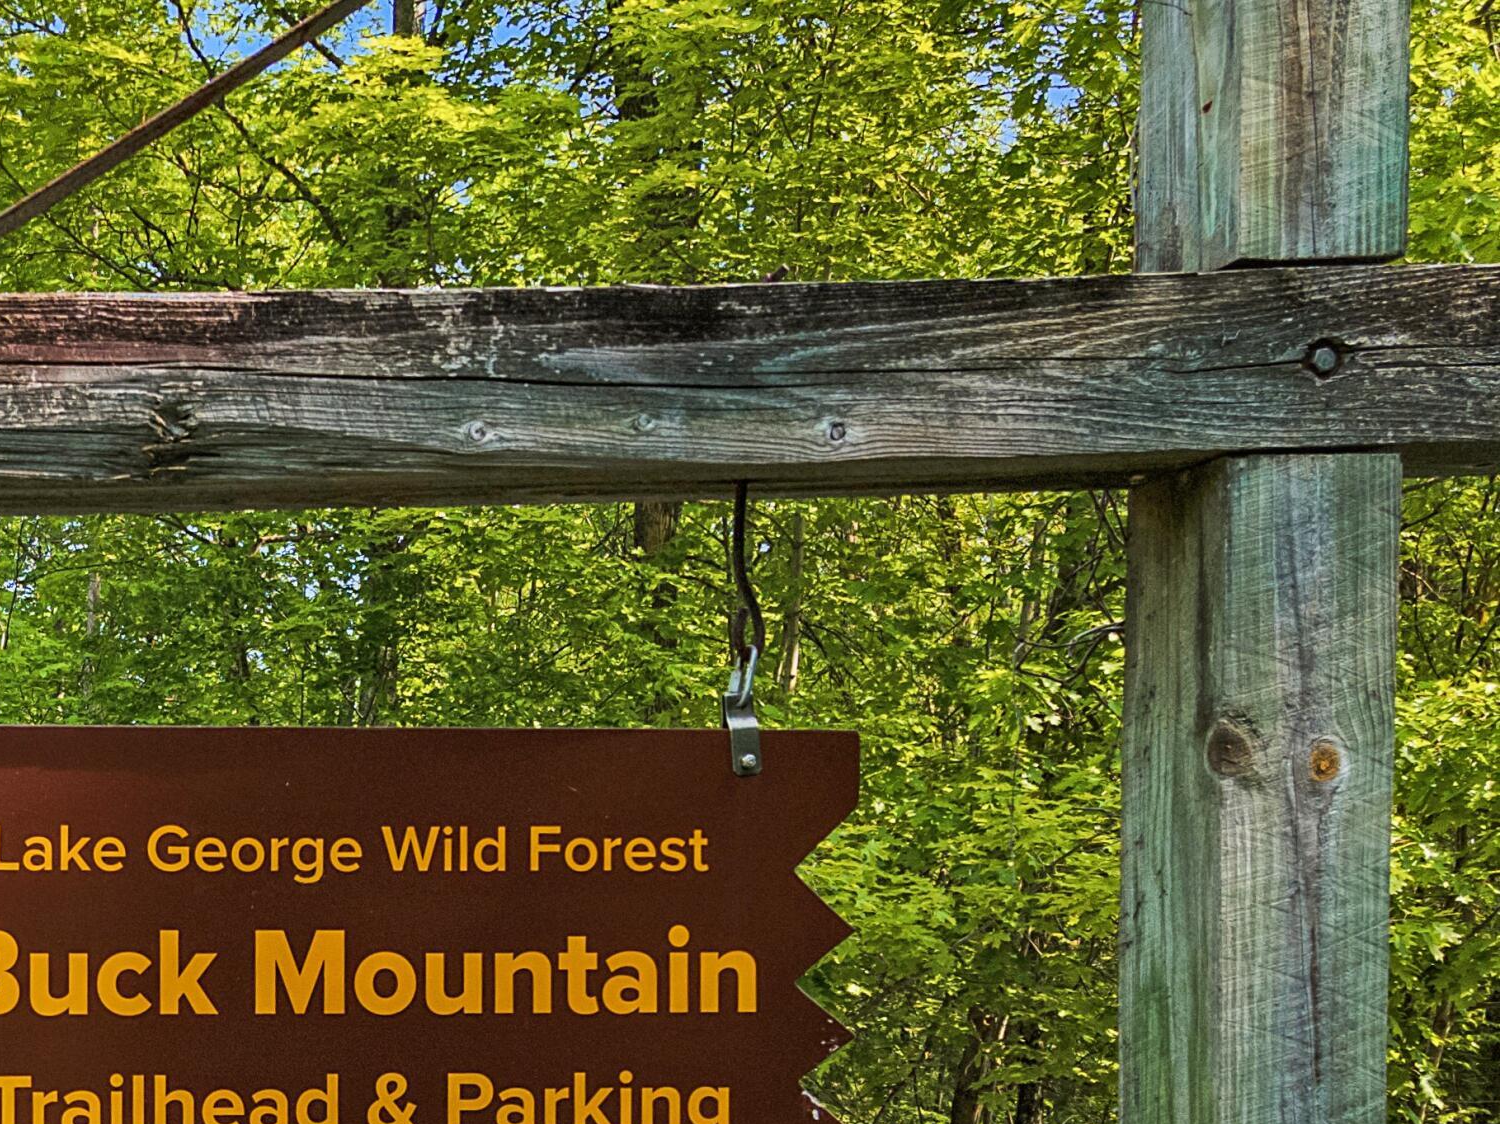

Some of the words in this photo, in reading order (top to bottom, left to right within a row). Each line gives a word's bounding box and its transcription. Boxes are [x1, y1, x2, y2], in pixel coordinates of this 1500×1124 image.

[148, 825, 362, 883] George
[382, 826, 505, 871] Wild
[531, 826, 708, 871] Forest
[255, 925, 756, 1015] Mountain
